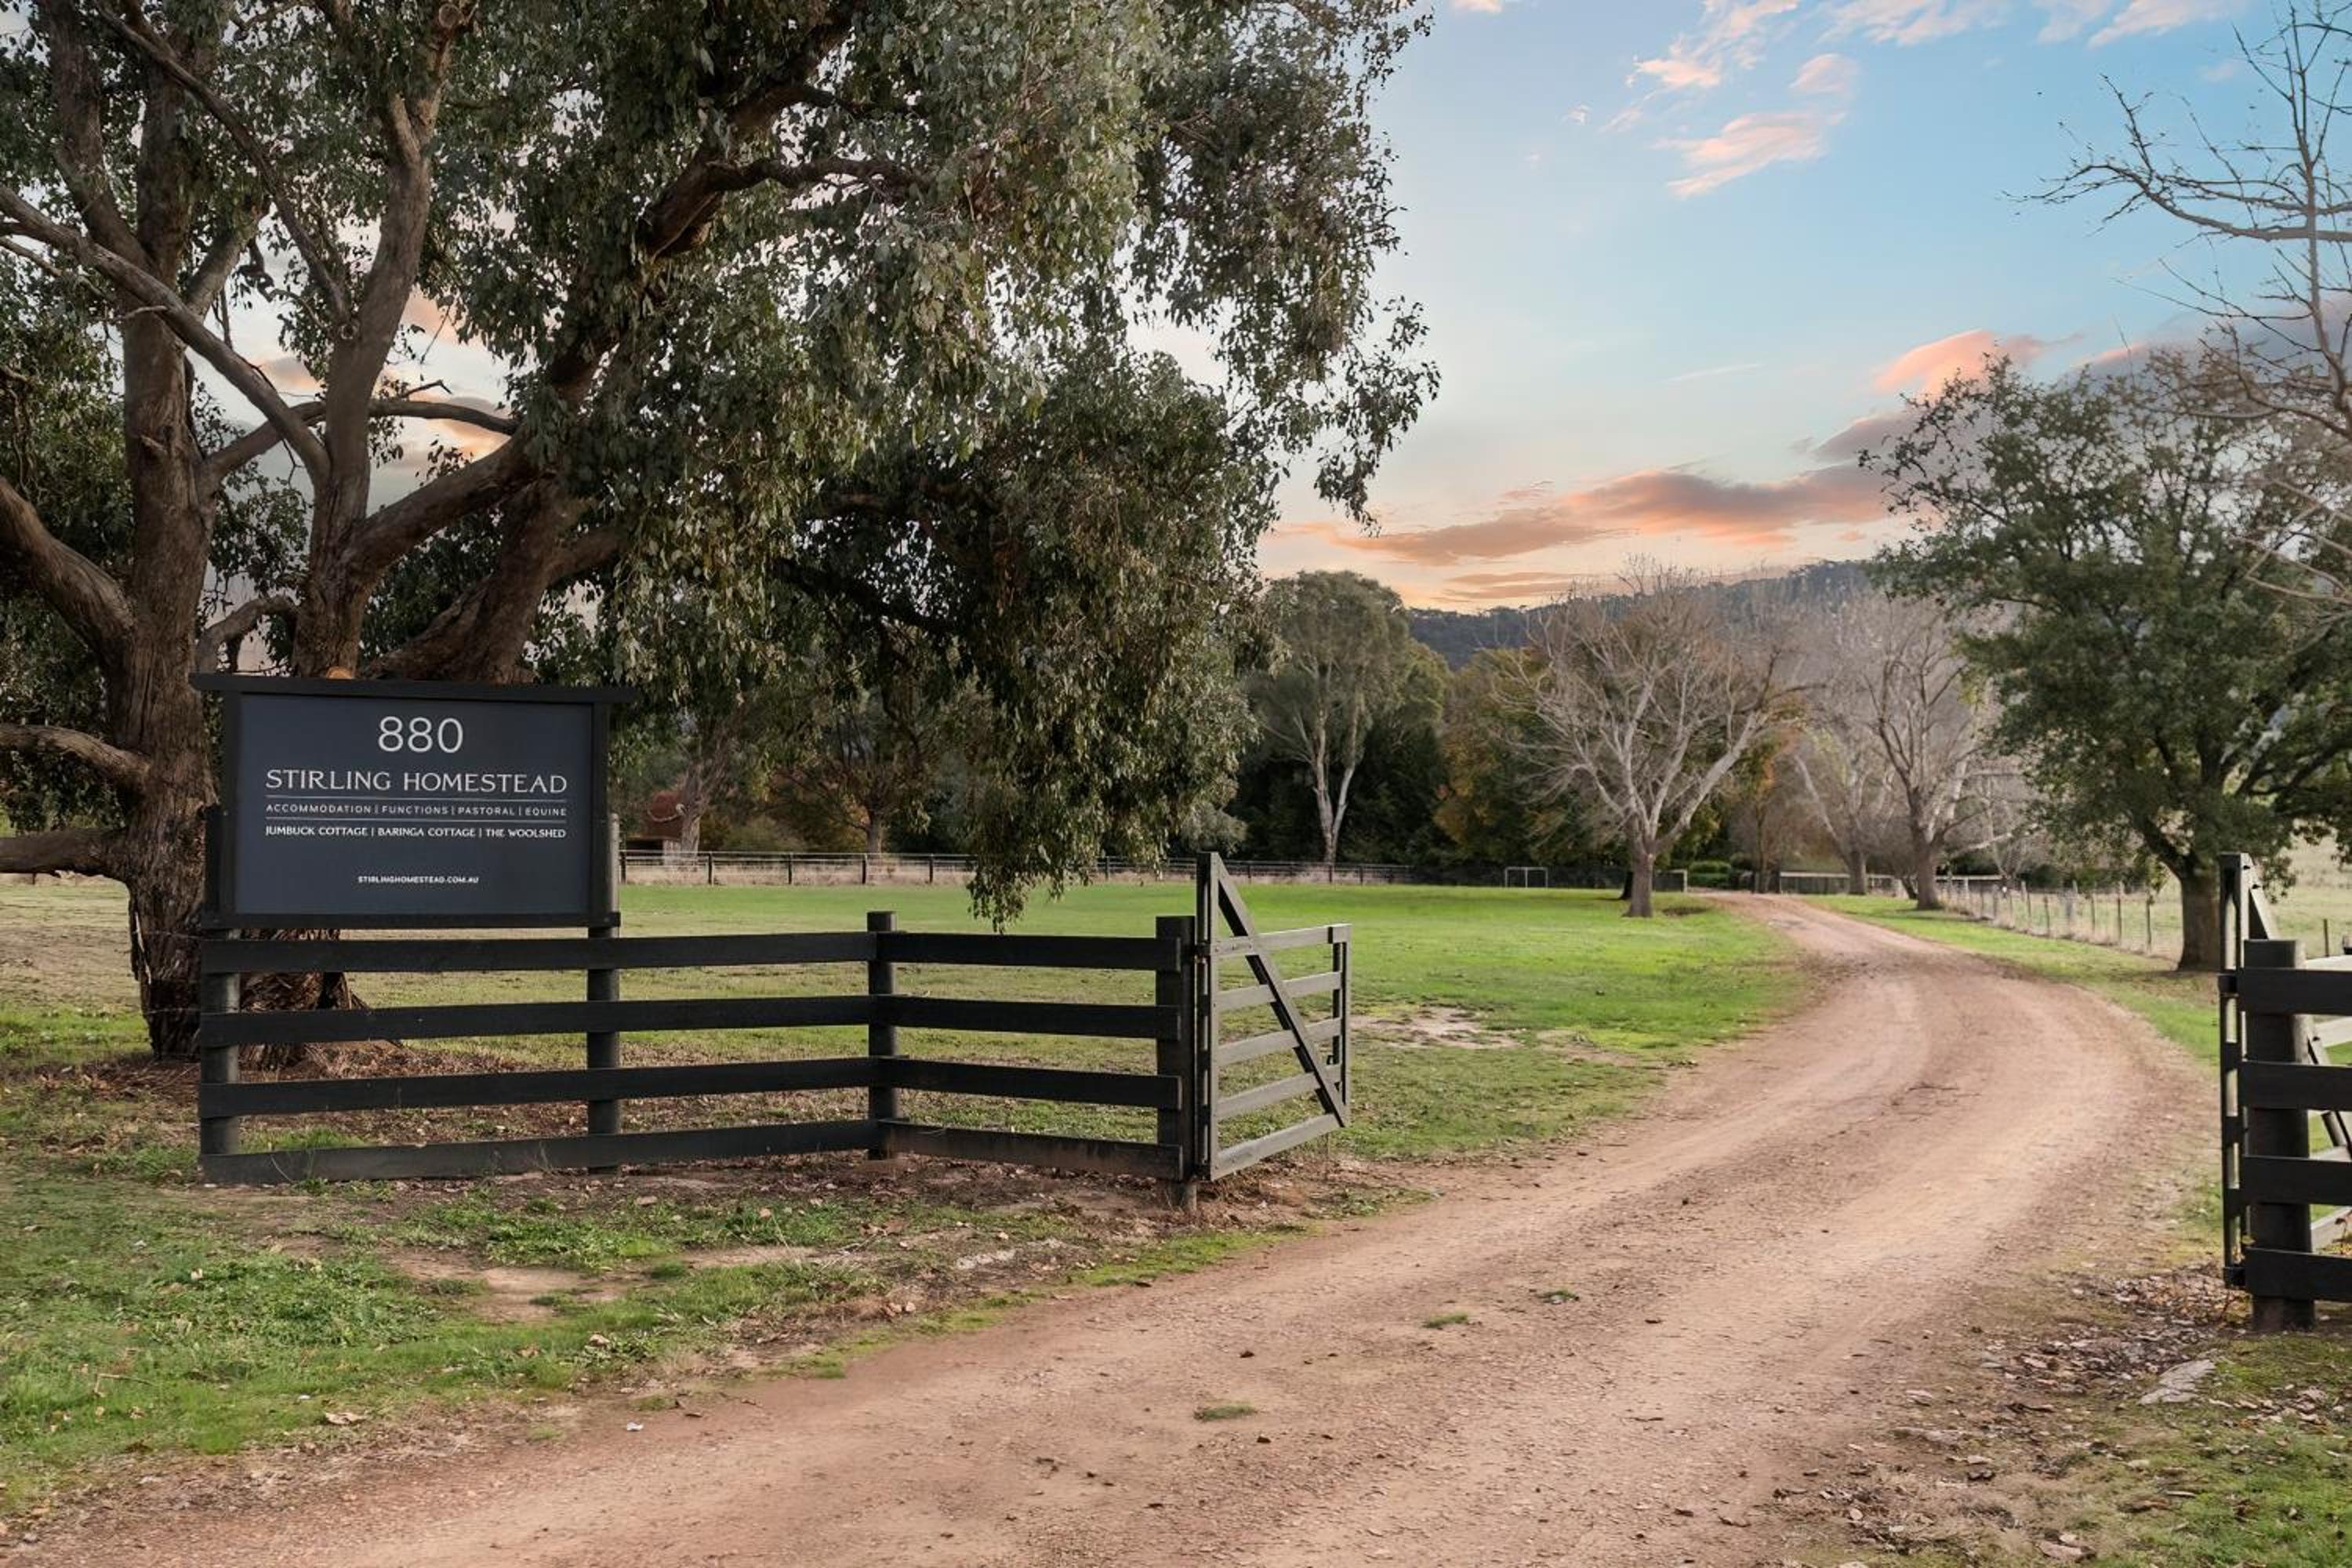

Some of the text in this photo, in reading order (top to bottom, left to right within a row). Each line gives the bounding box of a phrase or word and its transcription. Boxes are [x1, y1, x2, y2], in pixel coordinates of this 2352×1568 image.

[378, 717, 463, 753] 880
[265, 769, 567, 793] STIRLING HOMESTEAD
[266, 804, 567, 816] ACCOMMODATION FUNCTIONS PASTORAL EQUINE
[265, 826, 567, 838] JUMBUCK COTTAGE BARINGA COTTAGE THE WOOLSHED
